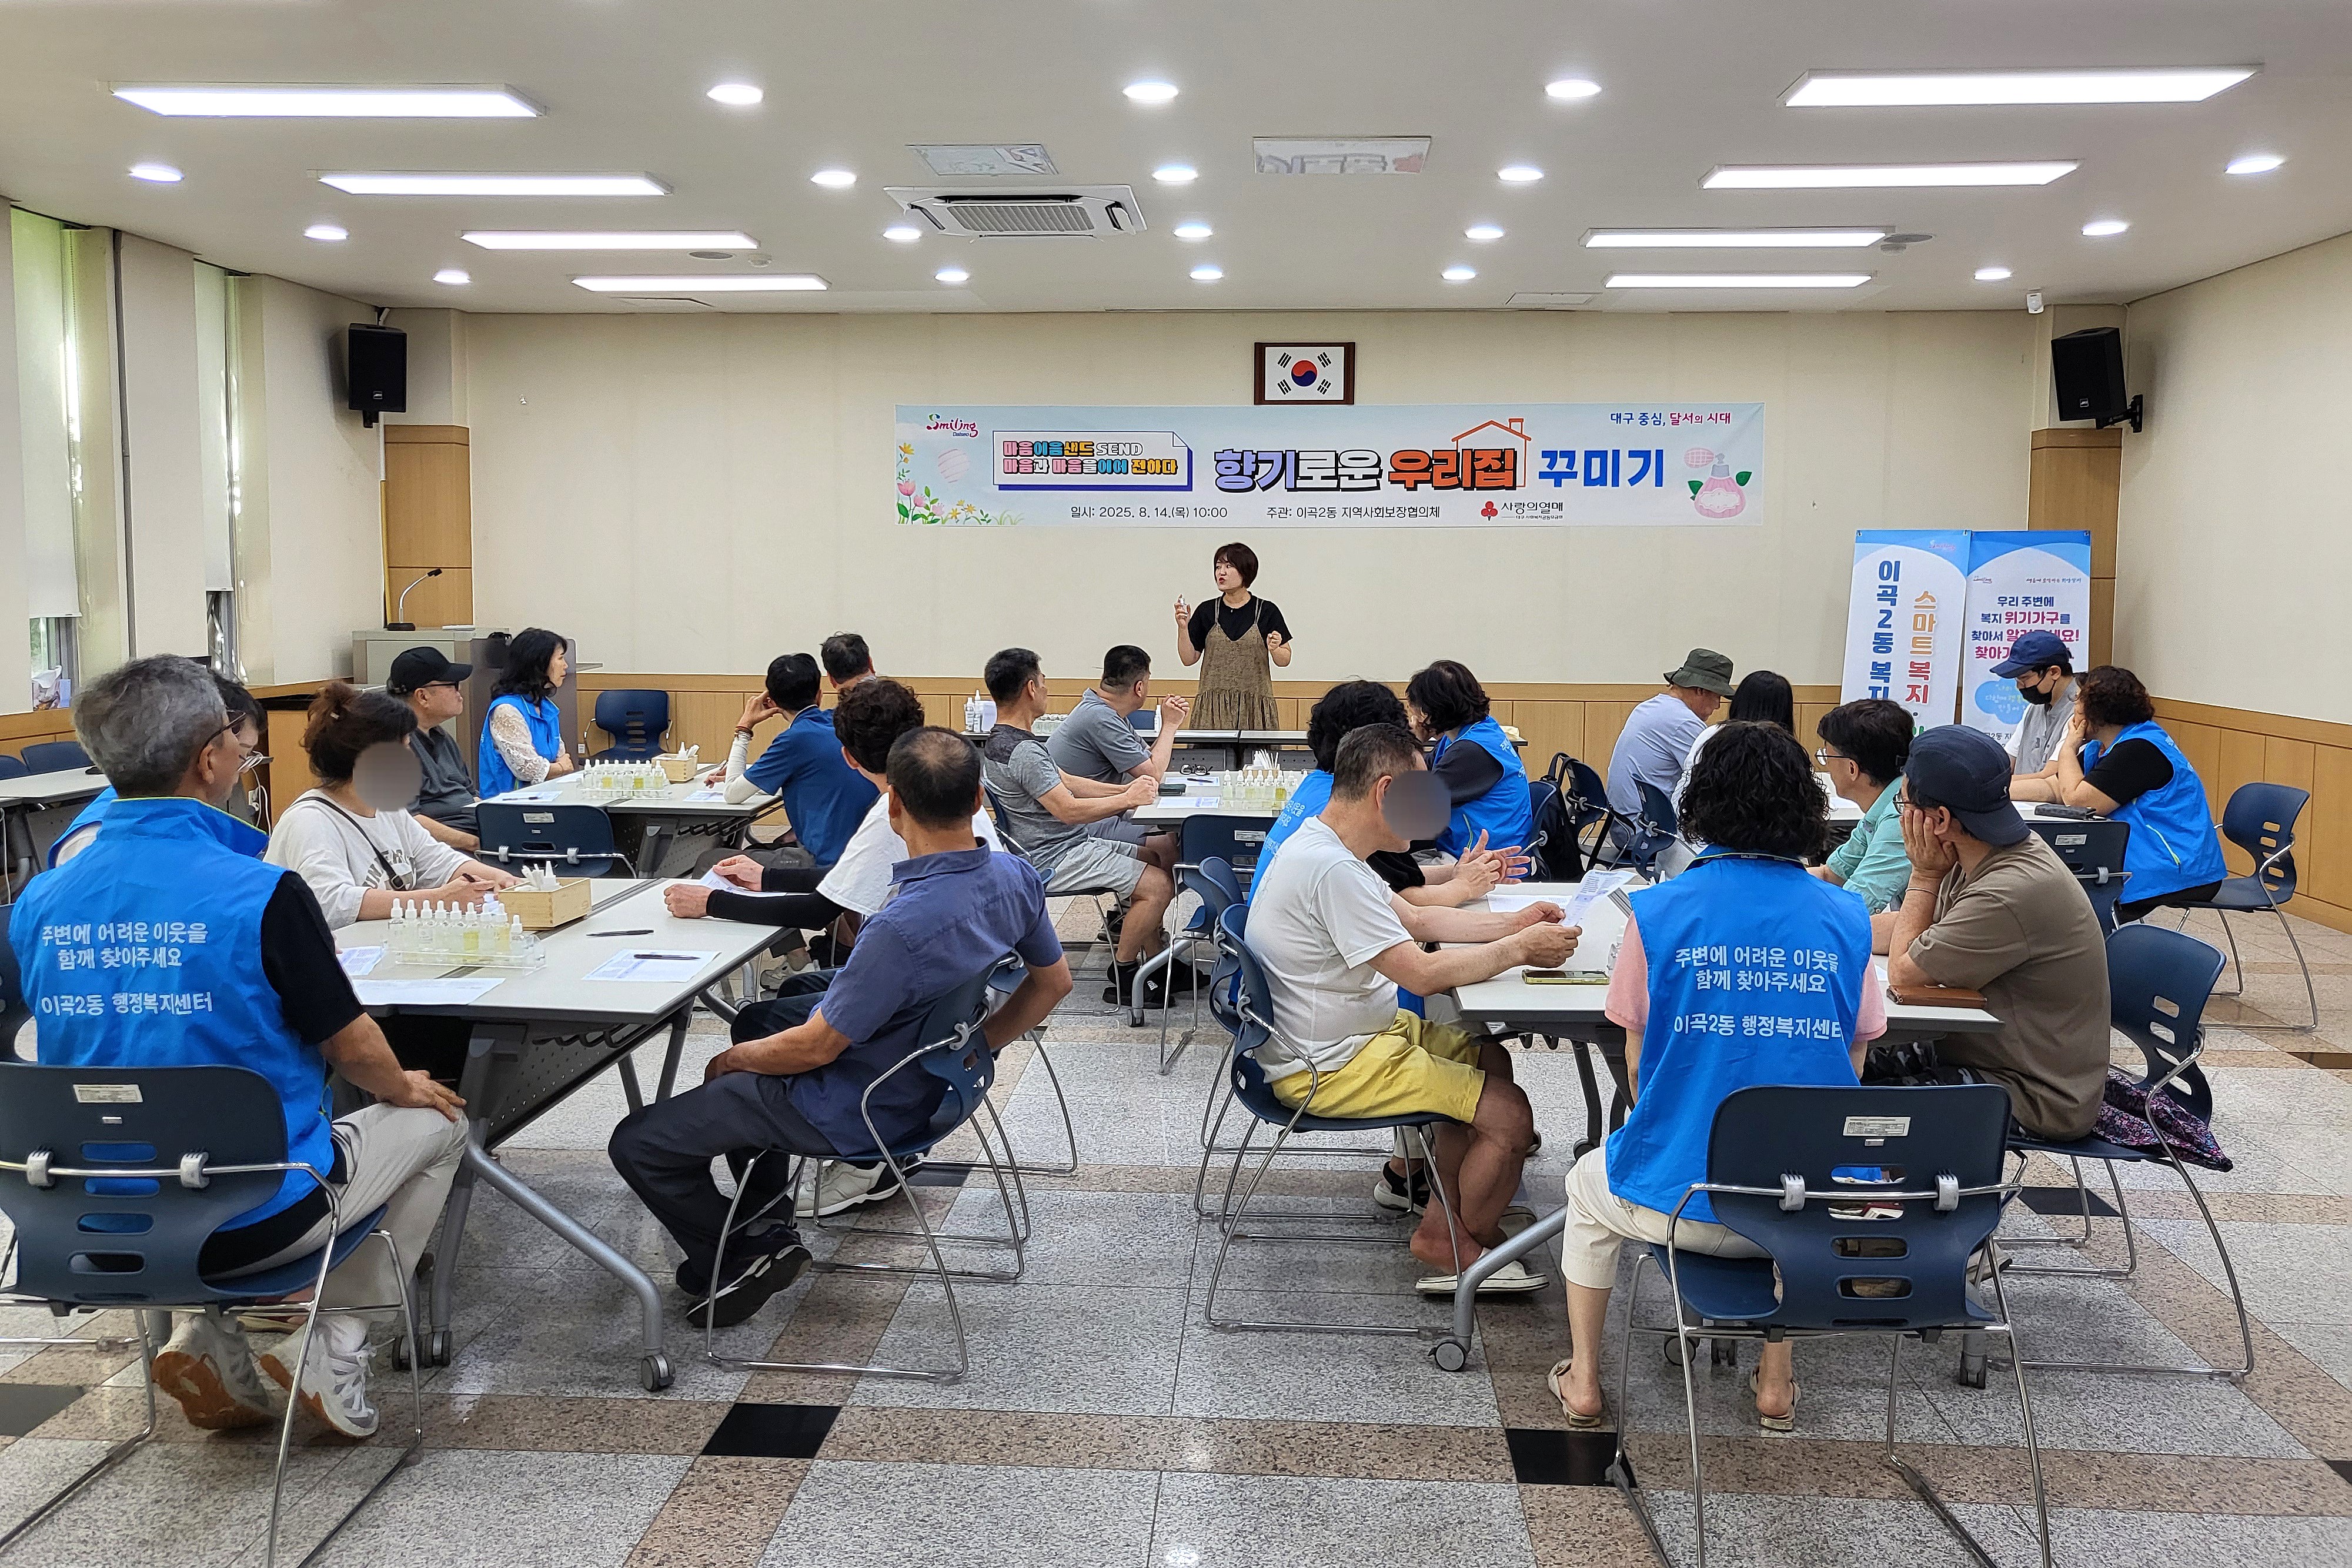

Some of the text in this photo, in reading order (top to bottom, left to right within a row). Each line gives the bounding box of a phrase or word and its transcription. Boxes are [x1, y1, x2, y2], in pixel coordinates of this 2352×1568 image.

[926, 413, 978, 438] Smiling
[1610, 412, 1731, 427] 대구 중심, 달서의 시대
[1096, 442, 1143, 456] SEND
[1003, 458, 1050, 474] 마음과
[1131, 459, 1178, 475] 전하다
[1214, 447, 1663, 493] 향기로운 우리집 꾸미기
[1071, 506, 1228, 519] 일시: 2025. 8. 14.(목) 10:00
[1266, 506, 1440, 519] 주관: 이곡2동 지역사회보장협의체
[1501, 502, 1563, 515] 사랑의열매
[1872, 560, 1900, 654] 이곡2동
[1997, 596, 2054, 607] 우리 주변에
[1909, 591, 1936, 655] 스마트
[1981, 611, 2070, 624] 복지 위기가구를
[1972, 630, 2003, 641] 찾아서
[1905, 661, 1931, 704] 복지
[42, 922, 208, 946] 주변에 어려운 이웃을
[58, 947, 182, 970] 함께 찾아주세요
[1675, 946, 1839, 974] 주변에 어려운 이웃을
[1695, 969, 1826, 994] 함께 찾아주세요
[41, 992, 212, 1016] 이곡2동 행정복지센터
[1674, 1013, 1736, 1035] 이곡2동
